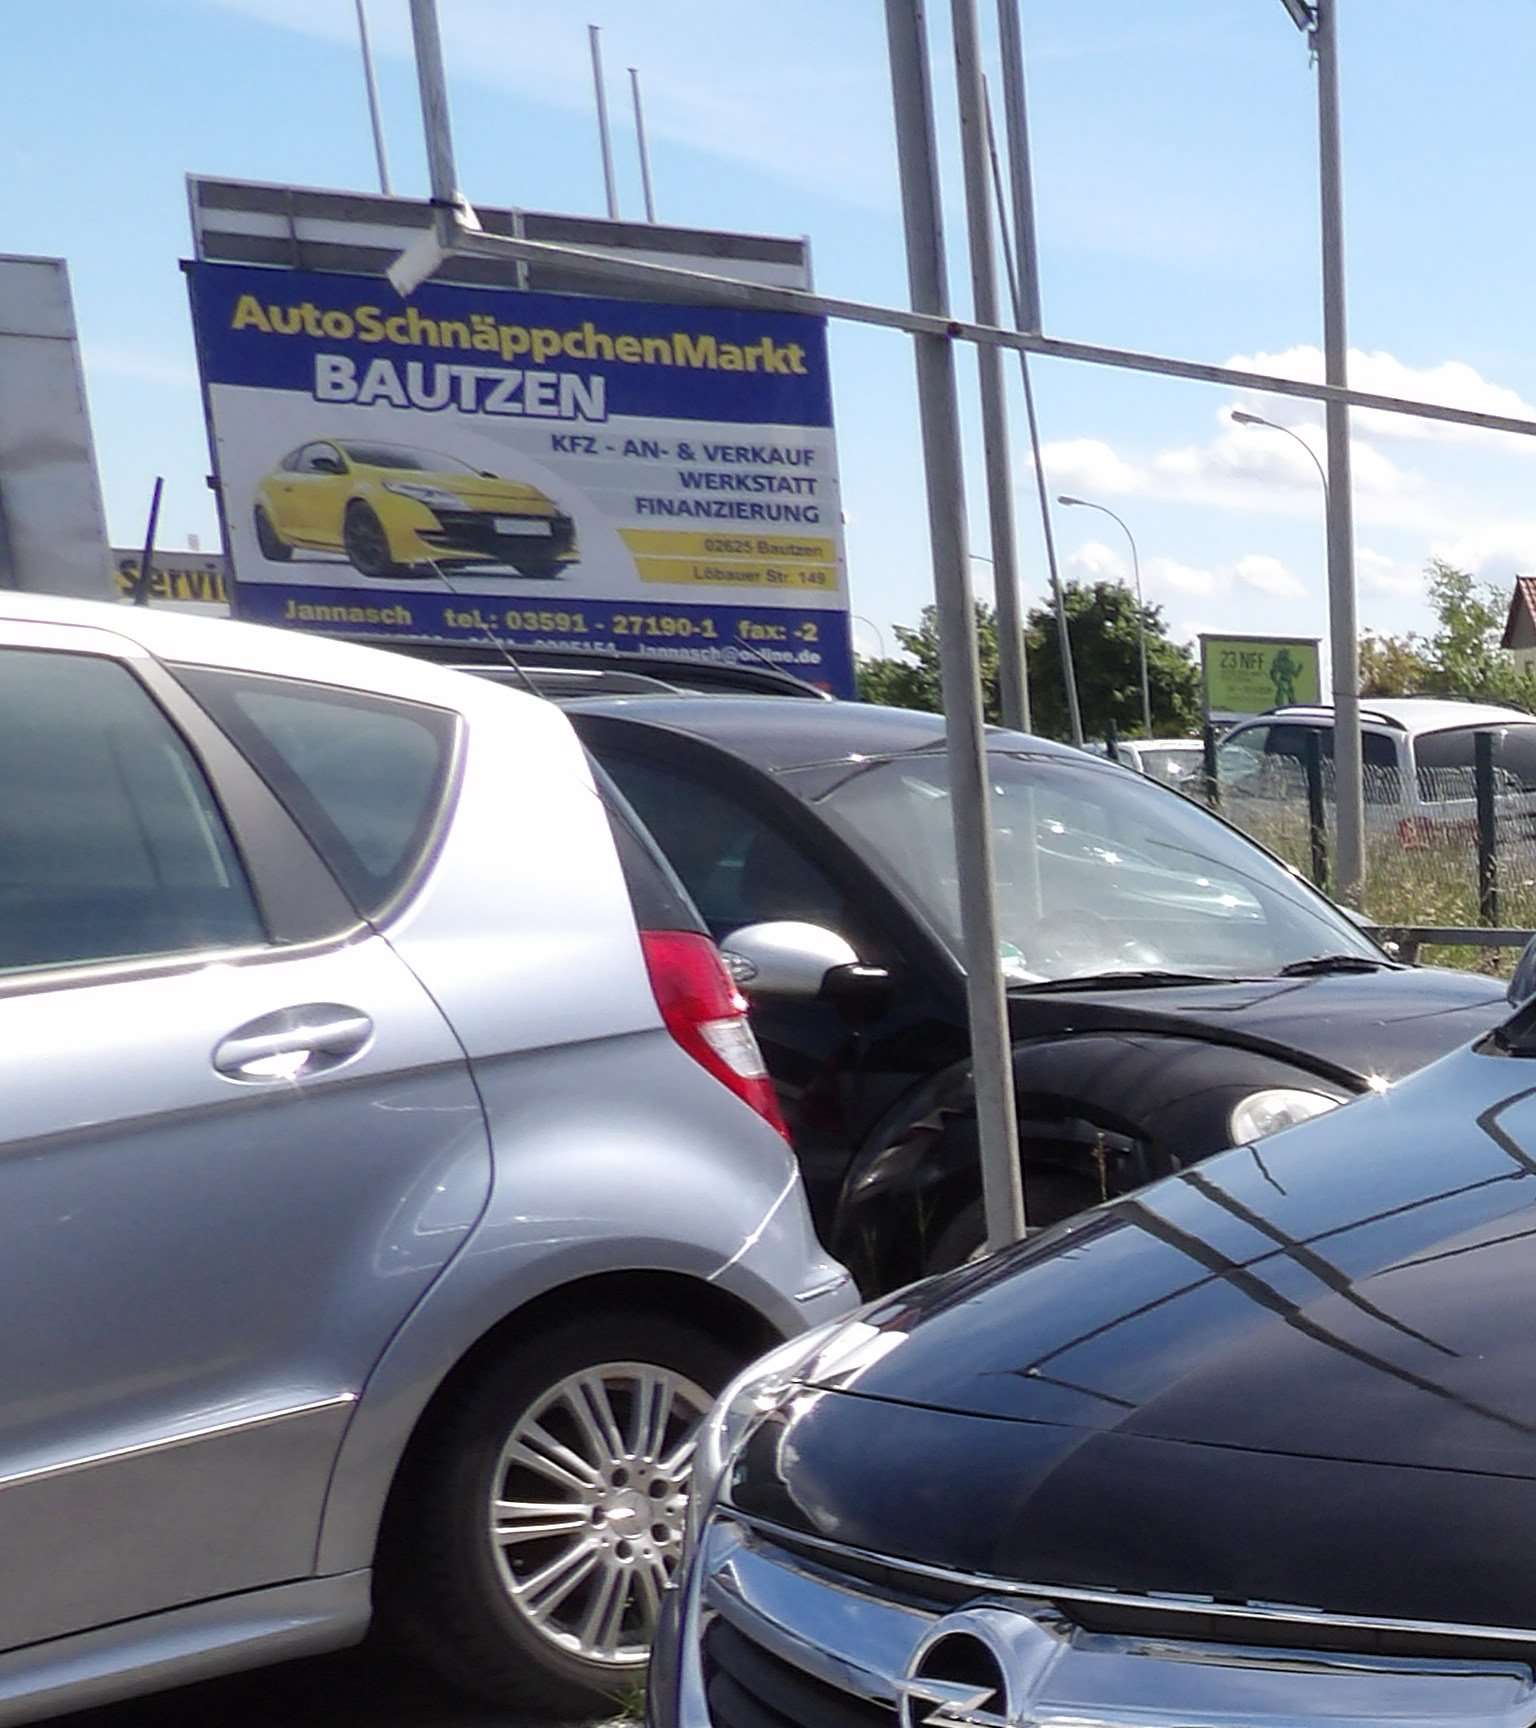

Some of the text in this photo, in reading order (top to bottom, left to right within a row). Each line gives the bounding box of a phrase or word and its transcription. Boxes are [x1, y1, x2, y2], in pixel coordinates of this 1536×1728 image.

[232, 295, 808, 375] AutoSchnäppchenMarkt
[313, 353, 607, 422] BAUTZEN
[551, 433, 598, 455] KFZ
[623, 439, 669, 460] AN-
[677, 442, 698, 462] &
[703, 444, 816, 468] VERKAUF
[679, 471, 818, 496] WERKSTATT
[635, 497, 820, 525] FINANZIERUNG
[704, 537, 824, 559] 02625 Bautzen
[284, 599, 413, 626] Jannasch
[506, 610, 589, 634] 03591
[612, 614, 719, 639] 27190-1
[738, 618, 787, 641] fax:
[793, 621, 819, 642] -2
